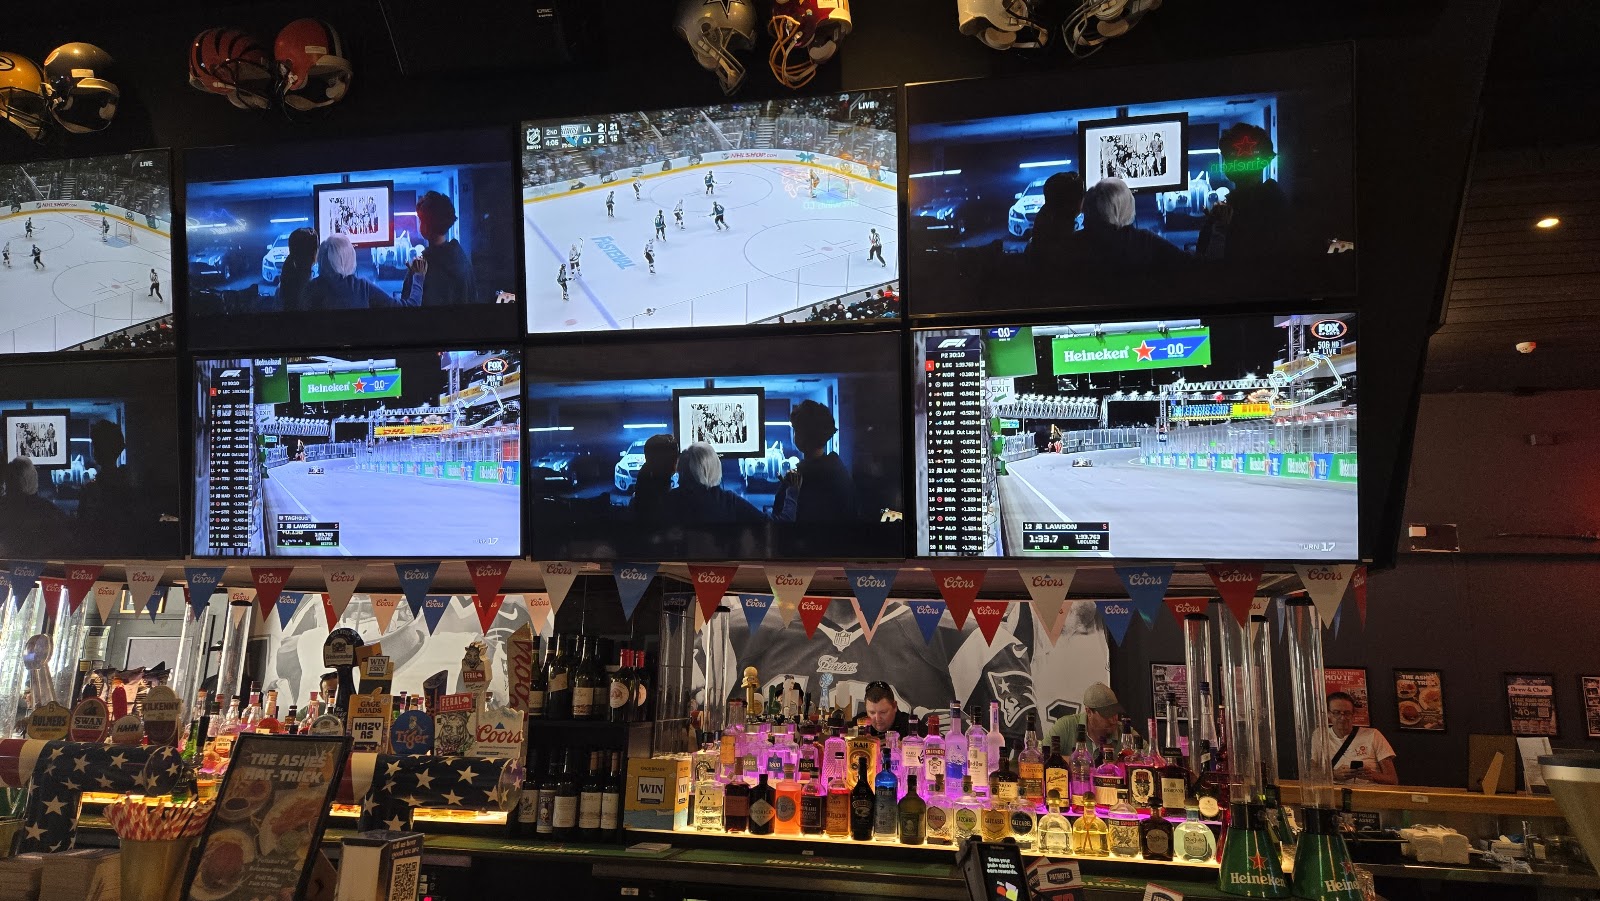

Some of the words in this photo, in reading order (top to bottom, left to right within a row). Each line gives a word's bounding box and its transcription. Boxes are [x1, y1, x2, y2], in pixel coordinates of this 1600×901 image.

[858, 101, 875, 110] LIVE
[598, 123, 604, 132] 2
[598, 134, 604, 144] 2
[591, 236, 636, 270] FASTENAL
[1318, 323, 1340, 332] FOX
[998, 328, 1010, 338] 0.0
[1064, 346, 1129, 362] Heineken
[1167, 343, 1184, 354] 0.0
[488, 360, 502, 368] FOX
[308, 382, 350, 394] Heineken
[374, 380, 384, 389] 0.0
[1029, 535, 1058, 543] 1:33.7
[1321, 542, 1336, 551] 17
[14, 566, 35, 576] Coors
[476, 566, 502, 576] Coors
[546, 563, 572, 575] Coors
[72, 570, 93, 580] Coors
[132, 572, 155, 582] Coors
[192, 572, 216, 584] Coors
[258, 574, 282, 584] Coors
[330, 572, 355, 583] Coors
[404, 570, 430, 580] Coors
[620, 568, 648, 581] Coors
[698, 571, 726, 584] Coors
[1218, 569, 1253, 583] Coors
[1307, 568, 1343, 581] Coors
[775, 574, 804, 586] Coors
[856, 576, 887, 588] Coors
[943, 576, 974, 589] Coors
[1031, 576, 1064, 588] Coors
[1129, 574, 1162, 586] Coors
[98, 586, 115, 596] Coors
[232, 592, 250, 600] Coors
[279, 594, 297, 604] Coors
[376, 599, 394, 608] Coors
[426, 598, 444, 608] Coors
[530, 598, 550, 607] Coors
[745, 598, 766, 608] Coors
[801, 601, 823, 610] Coors
[916, 604, 939, 615] Coors
[976, 605, 1000, 616] Coors
[1104, 604, 1129, 615] Coors
[1175, 604, 1200, 613] Coors
[817, 655, 858, 674] Patriots
[142, 702, 180, 711] KILKENNY
[442, 697, 462, 707] FERAL
[74, 717, 103, 725] SWAN
[116, 724, 140, 732] HAHN
[344, 722, 382, 731] HAZY
[360, 731, 374, 739] AS
[476, 724, 524, 744] Coors
[396, 730, 428, 749] Tiger
[250, 753, 278, 765] THE
[278, 754, 327, 768] ASHES
[244, 768, 322, 783] HAT-TRICK
[640, 784, 663, 794] WIN
[765, 859, 863, 869] Heineken
[1048, 872, 1071, 880] PATRIOTS
[1230, 872, 1286, 888] Heineken
